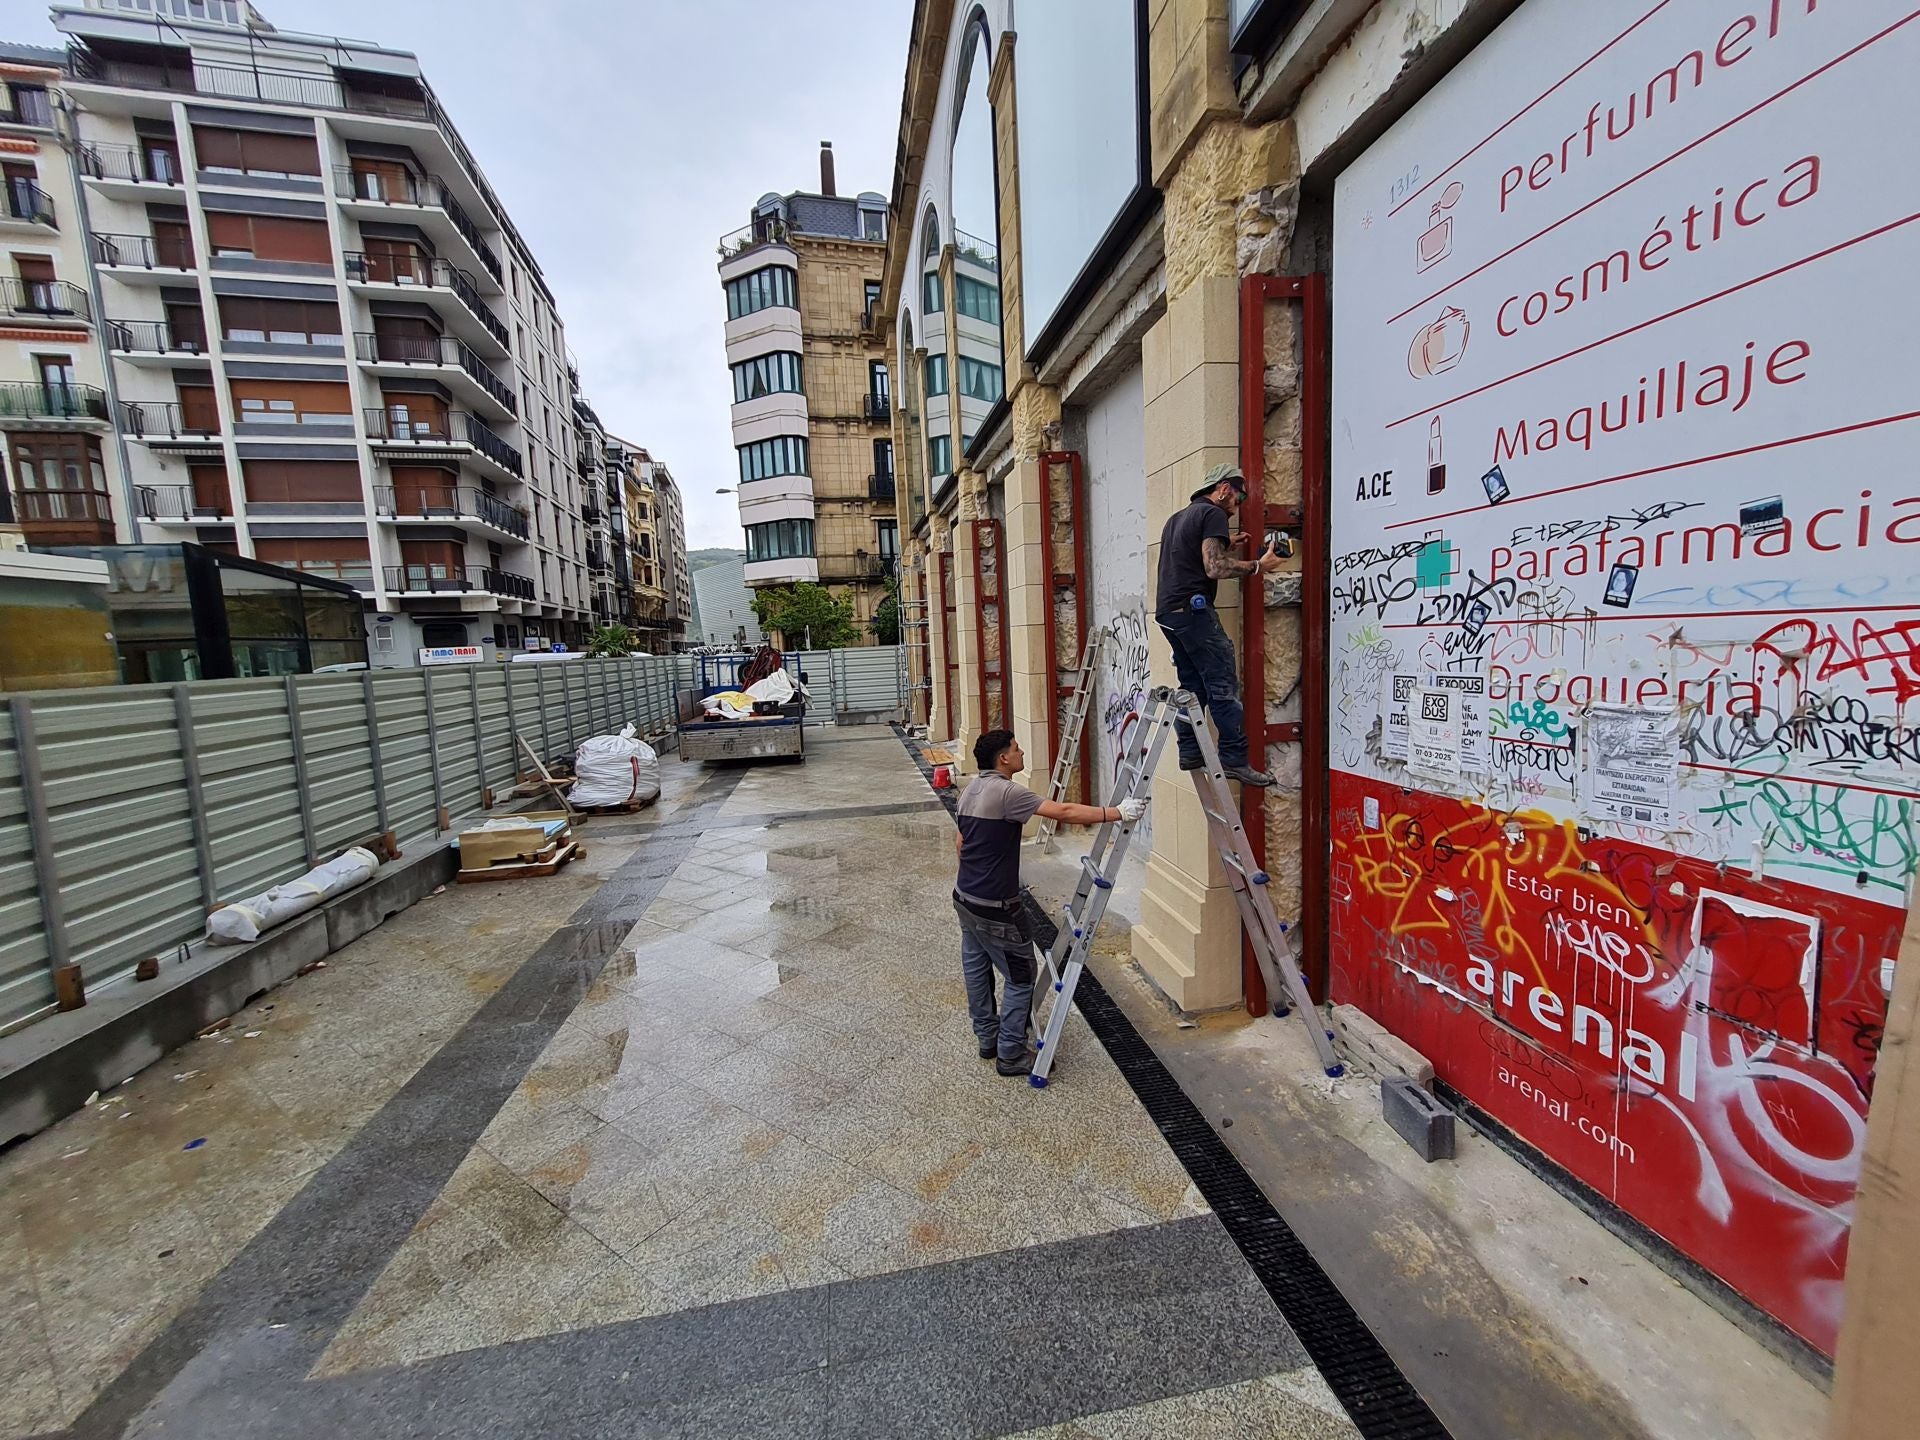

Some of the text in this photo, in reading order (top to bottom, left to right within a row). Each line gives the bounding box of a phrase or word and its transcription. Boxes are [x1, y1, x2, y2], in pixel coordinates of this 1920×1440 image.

[1496, 154, 1822, 337] Cosmética
[1493, 339, 1811, 464] Maquillaje
[1356, 470, 1393, 502] A.CE
[1490, 489, 1920, 586] Parafarmacia
[1395, 689, 1410, 699] DU
[1424, 706, 1446, 718] DUS
[1425, 696, 1446, 707] EXO
[1438, 679, 1481, 691] EXODUS
[1488, 664, 1762, 718] Droguería
[1507, 868, 1639, 931] Estar bien.
[1465, 953, 1698, 1103] arenal
[1498, 1065, 1635, 1164] arenal.com
